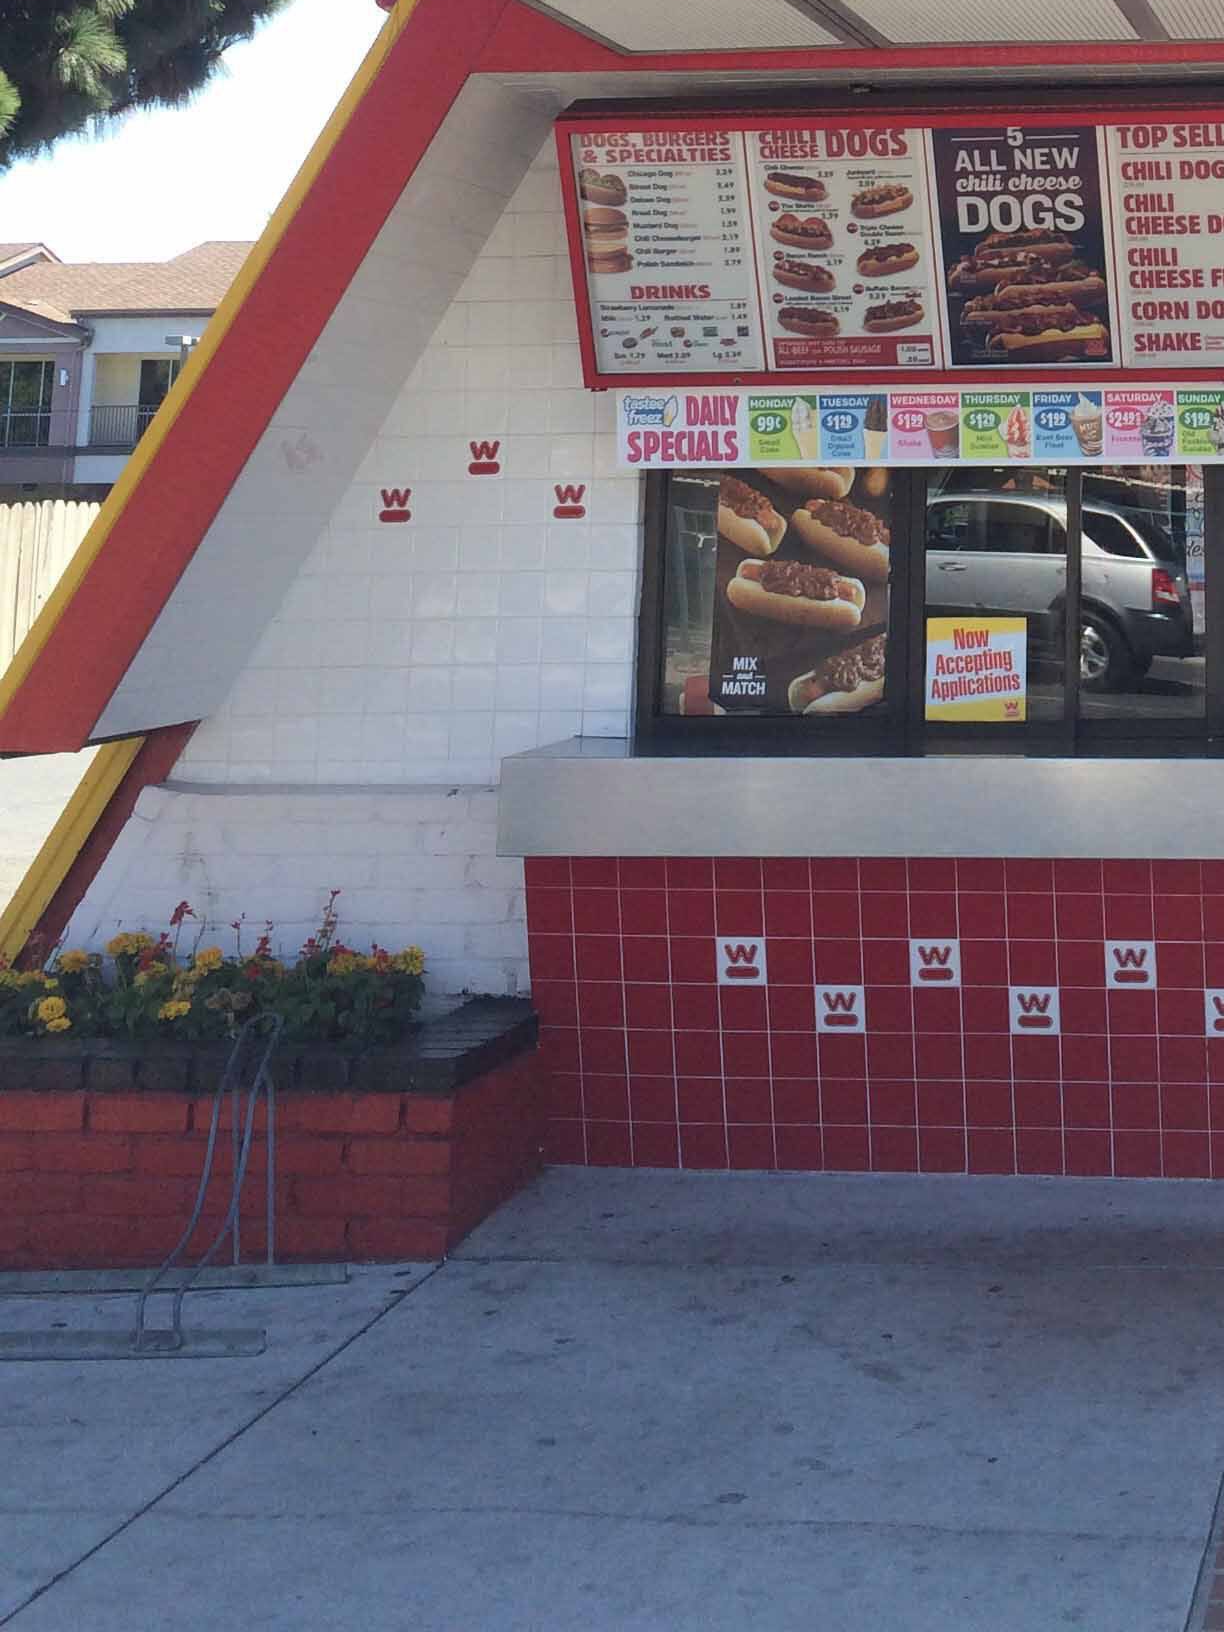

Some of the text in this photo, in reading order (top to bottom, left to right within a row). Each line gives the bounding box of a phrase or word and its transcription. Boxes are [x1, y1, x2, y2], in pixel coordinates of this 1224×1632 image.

[642, 132, 730, 147] BURGERS
[759, 128, 907, 157] CHILI DOGS
[1007, 127, 1023, 147] 5
[1117, 126, 1167, 148] TOP
[583, 148, 731, 163] & SPECIALTIES
[760, 144, 819, 159] CHEESE
[955, 147, 1079, 172] ALL NEW
[1121, 162, 1172, 180] CHILI
[956, 172, 1082, 192] chili cheese
[1124, 194, 1174, 212] CHILI
[957, 194, 1085, 233] DOGS
[1126, 216, 1200, 234] CHEESE
[1128, 247, 1178, 266] CHILI
[1129, 270, 1204, 288] CHEESE
[631, 285, 711, 299] DRINKS
[1132, 302, 1189, 320] CORN
[1134, 333, 1201, 352] SHAKE
[750, 399, 796, 408] MONDAY
[822, 398, 869, 407] TUESDAY
[891, 395, 957, 405] WEDNESDAY
[965, 394, 1021, 403] THURSDAY
[1034, 394, 1072, 403] FRIDAY
[1106, 393, 1162, 402] SATURDAY
[1178, 394, 1221, 403] SUNDAY
[623, 396, 740, 426] tastee DAILY
[627, 410, 664, 426] freez
[470, 440, 500, 460] W
[627, 431, 739, 462] SPECIALS
[380, 489, 411, 508] W
[554, 484, 585, 504] W
[953, 628, 989, 650] Now
[733, 657, 757, 670] MIX
[935, 649, 1012, 676] Accepting
[722, 682, 765, 695] MATCH
[931, 672, 1020, 702] Applications
[724, 943, 758, 964] W
[917, 945, 951, 966] W
[1112, 948, 1146, 968] W
[822, 991, 857, 1012] W
[1016, 992, 1051, 1013] W
